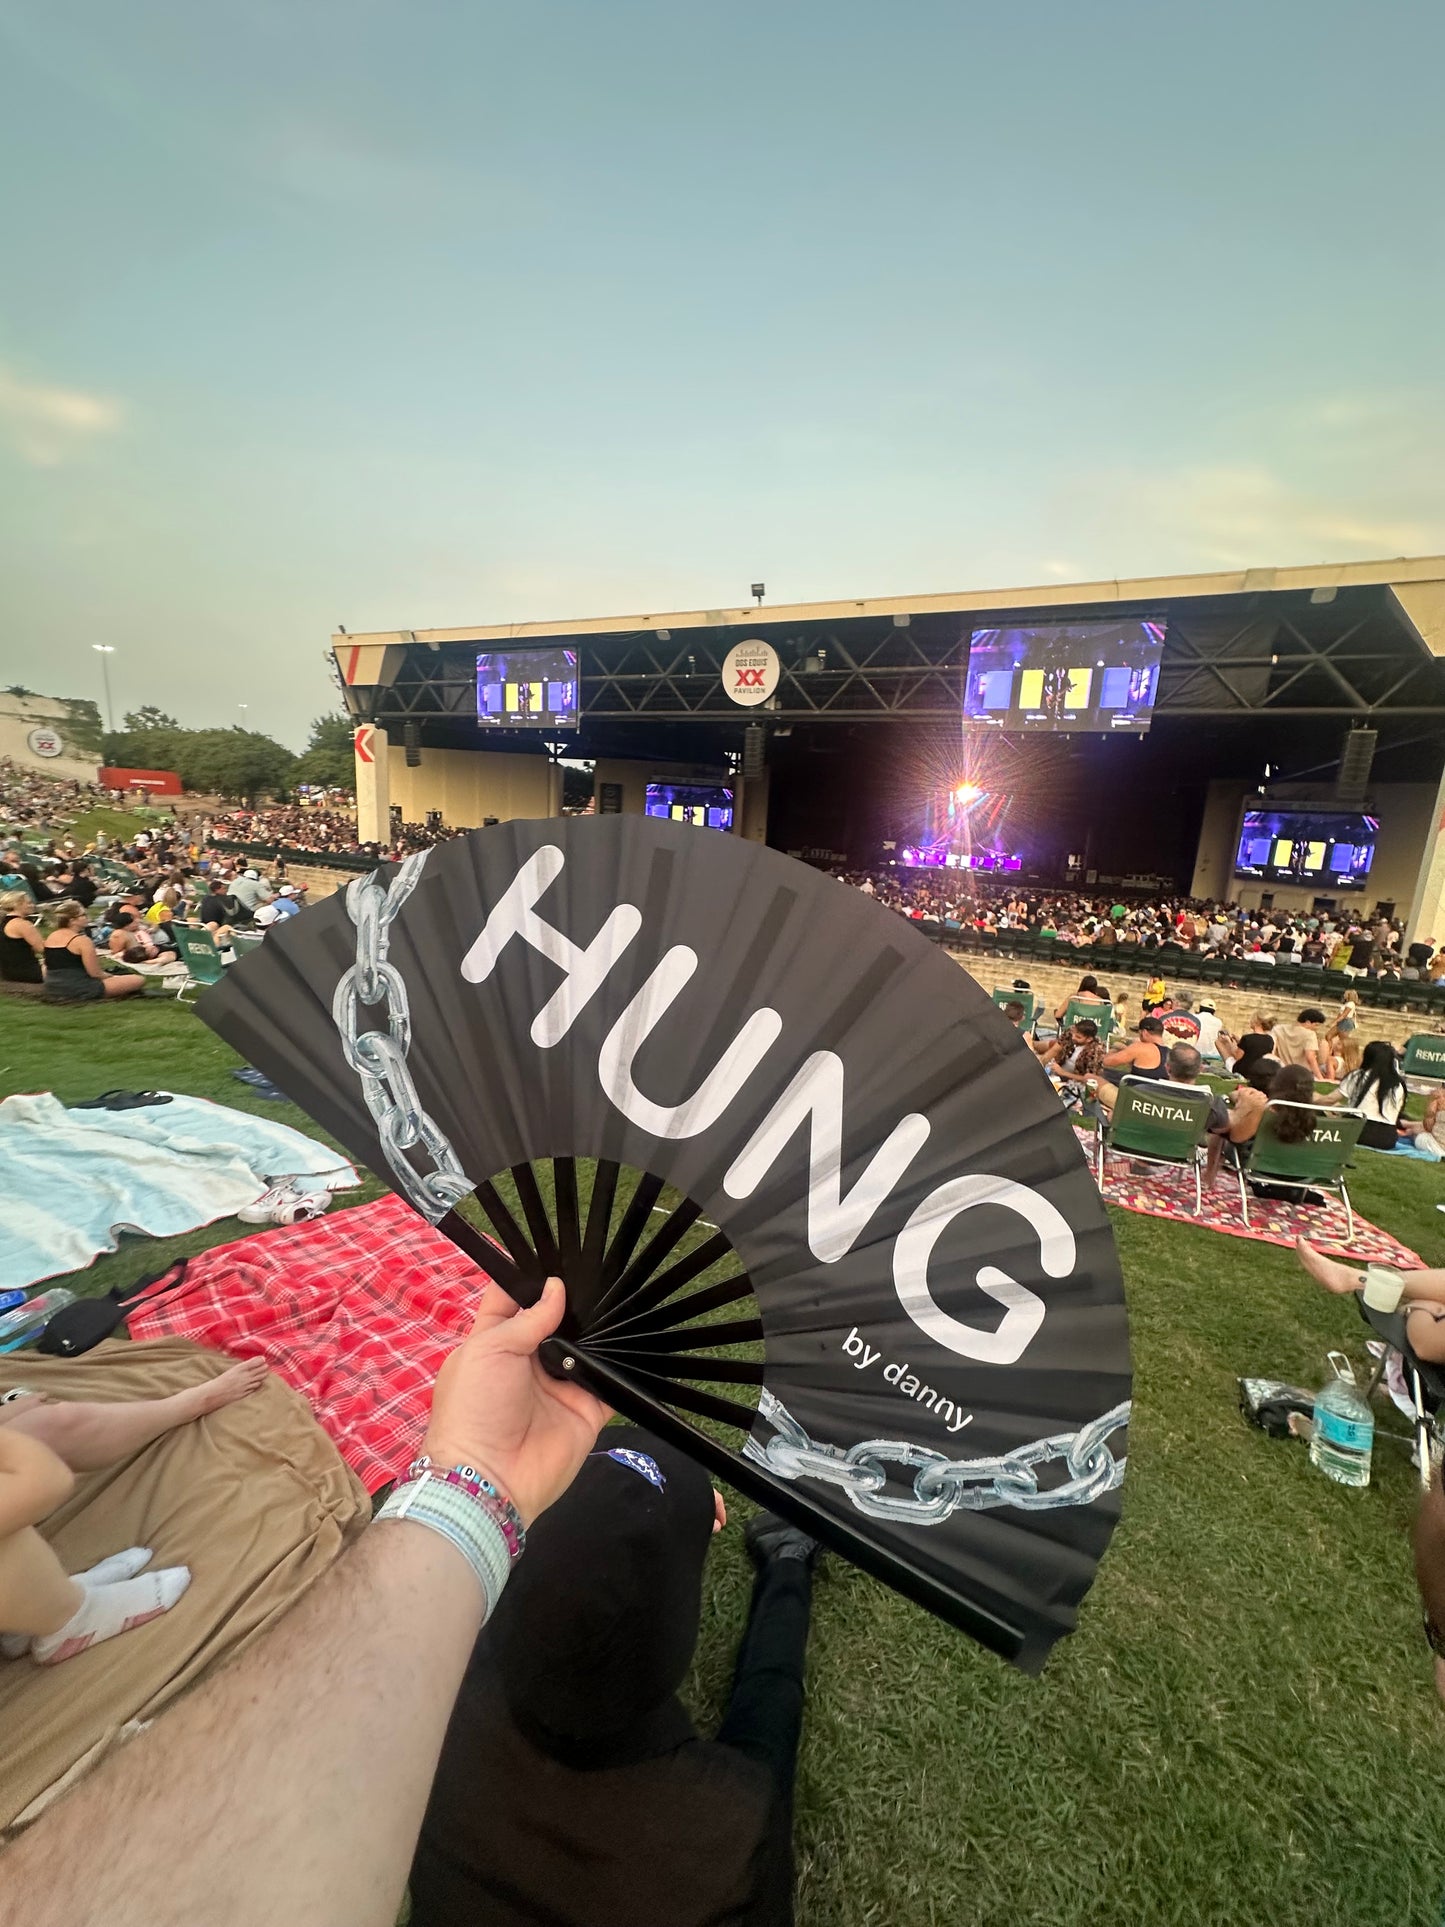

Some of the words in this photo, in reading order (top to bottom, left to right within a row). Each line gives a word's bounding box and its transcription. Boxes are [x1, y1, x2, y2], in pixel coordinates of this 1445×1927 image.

[735, 659, 748, 667] DOS
[735, 669, 767, 687] XX
[1415, 1048, 1445, 1062] RENTA
[460, 844, 1077, 1365] HUNG
[1131, 1099, 1193, 1121] RENTAL
[1305, 1129, 1342, 1142] TAL
[841, 1326, 882, 1370] by
[883, 1363, 974, 1433] danny
